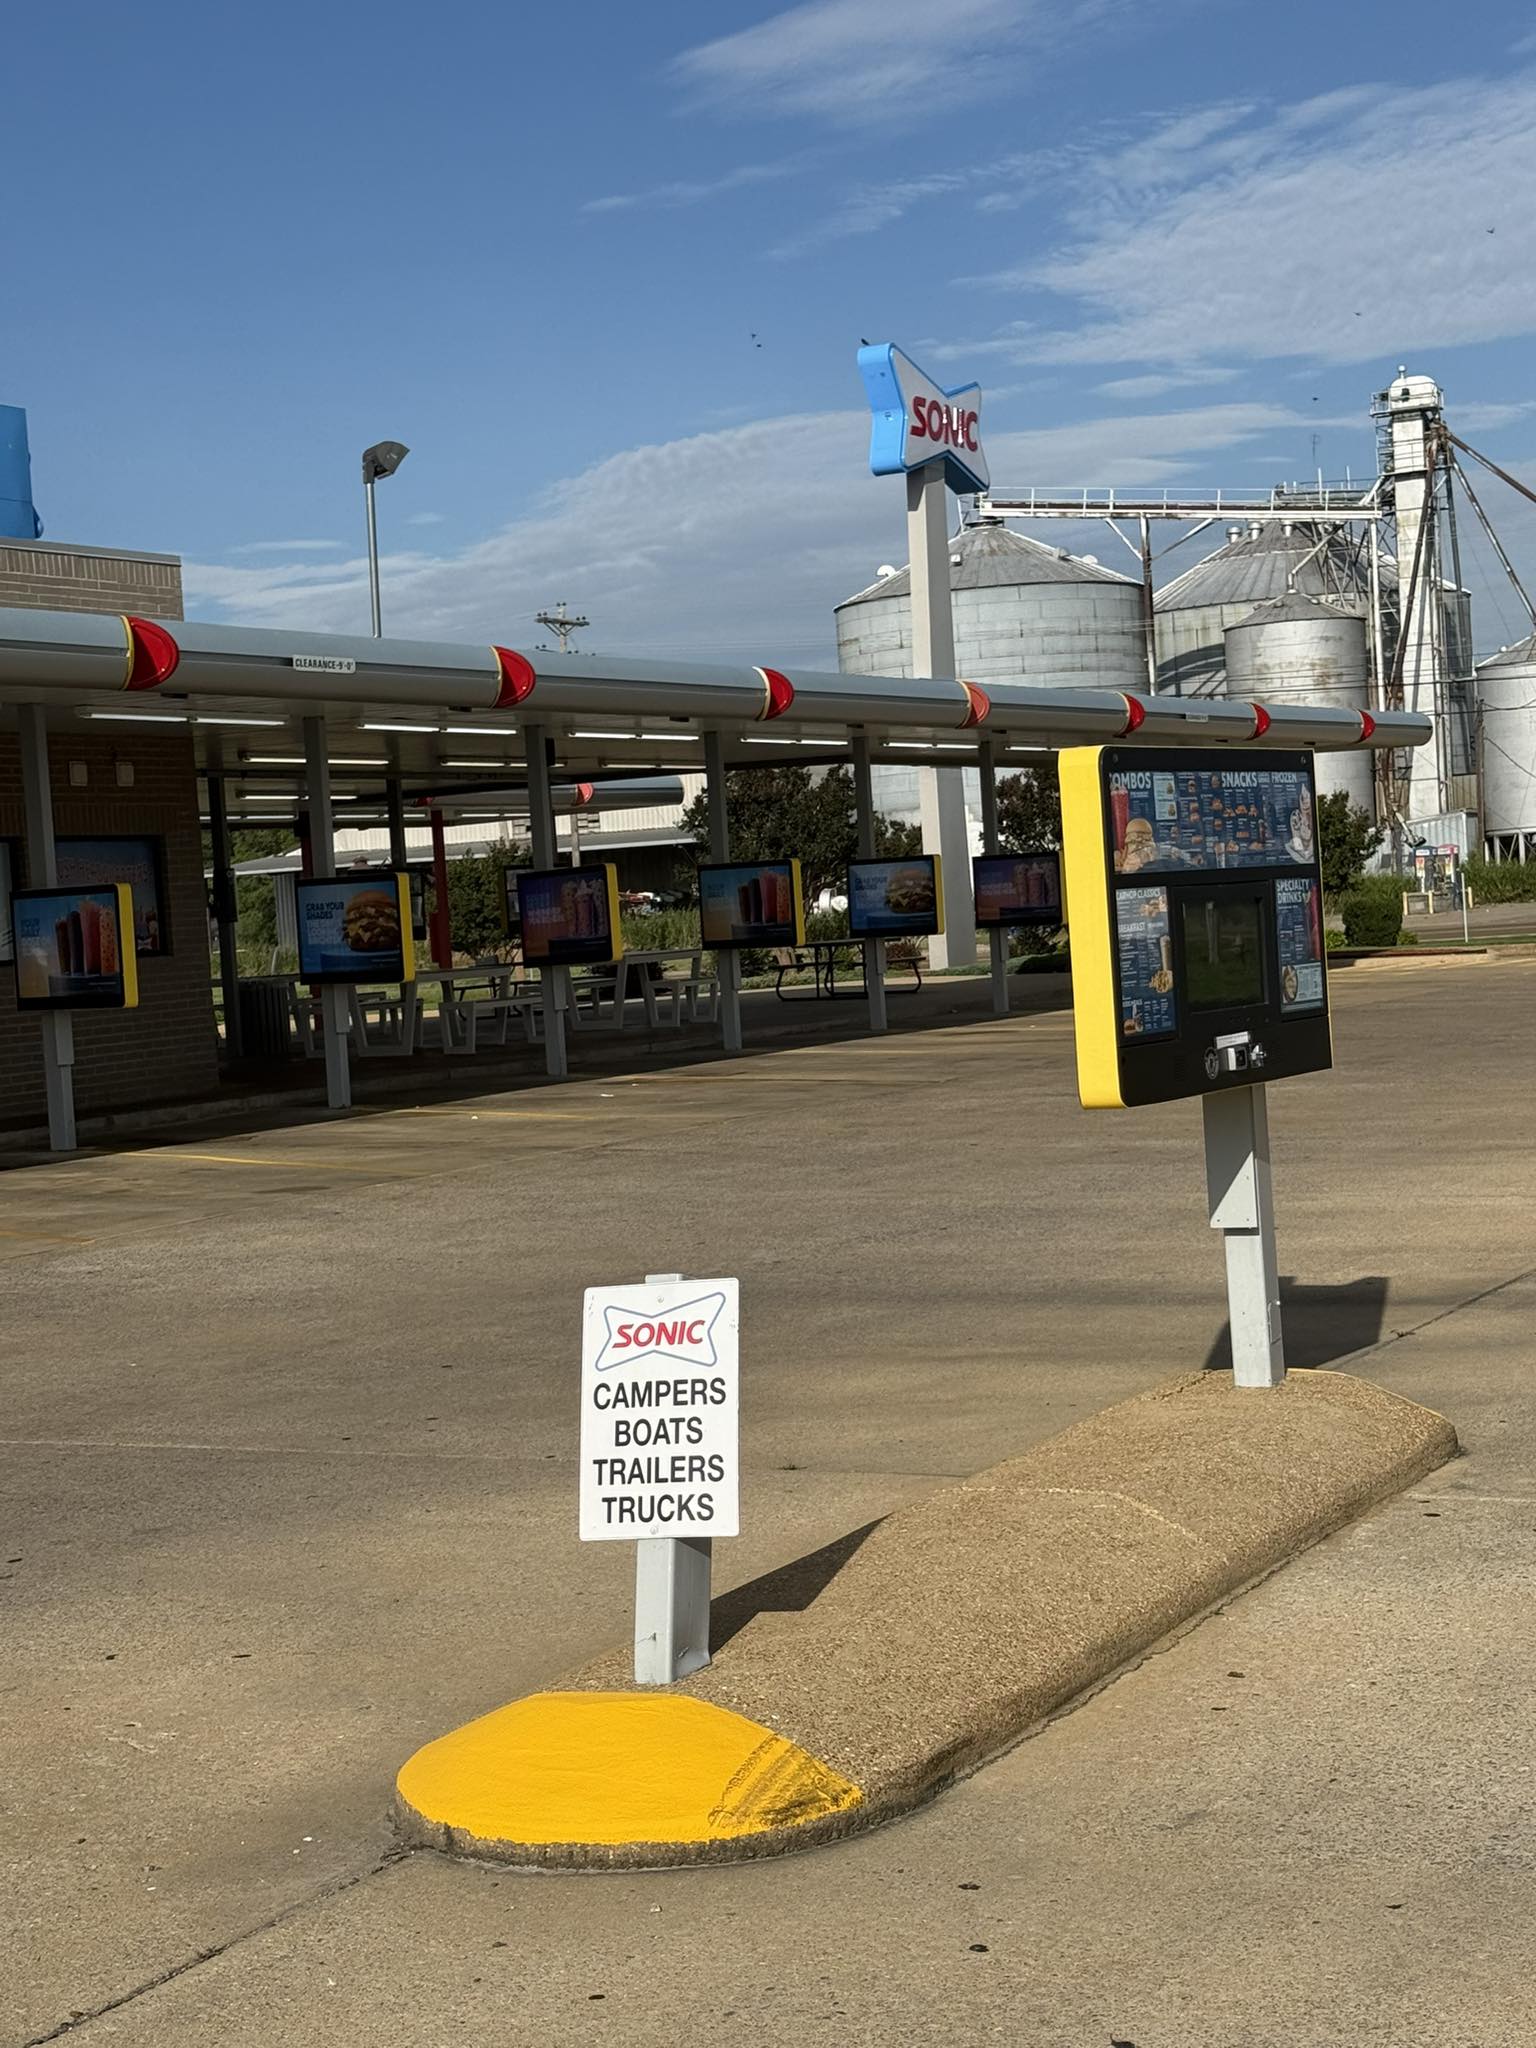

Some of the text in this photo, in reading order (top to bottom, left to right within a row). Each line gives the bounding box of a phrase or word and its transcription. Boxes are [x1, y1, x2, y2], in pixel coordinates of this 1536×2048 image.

[910, 396, 978, 452] SONIC
[1109, 772, 1152, 790] OMBOS
[1221, 771, 1258, 788] SNACKS
[1271, 771, 1297, 784] FROZEN
[1277, 879, 1310, 892] SPECIALTY
[1278, 891, 1303, 904] DRINKS
[611, 1319, 706, 1349] SONIC
[593, 1377, 727, 1410] CAMPERS
[614, 1416, 704, 1447] BOATS
[592, 1454, 725, 1486] TRAILERS
[601, 1493, 715, 1524] TRUCKS
